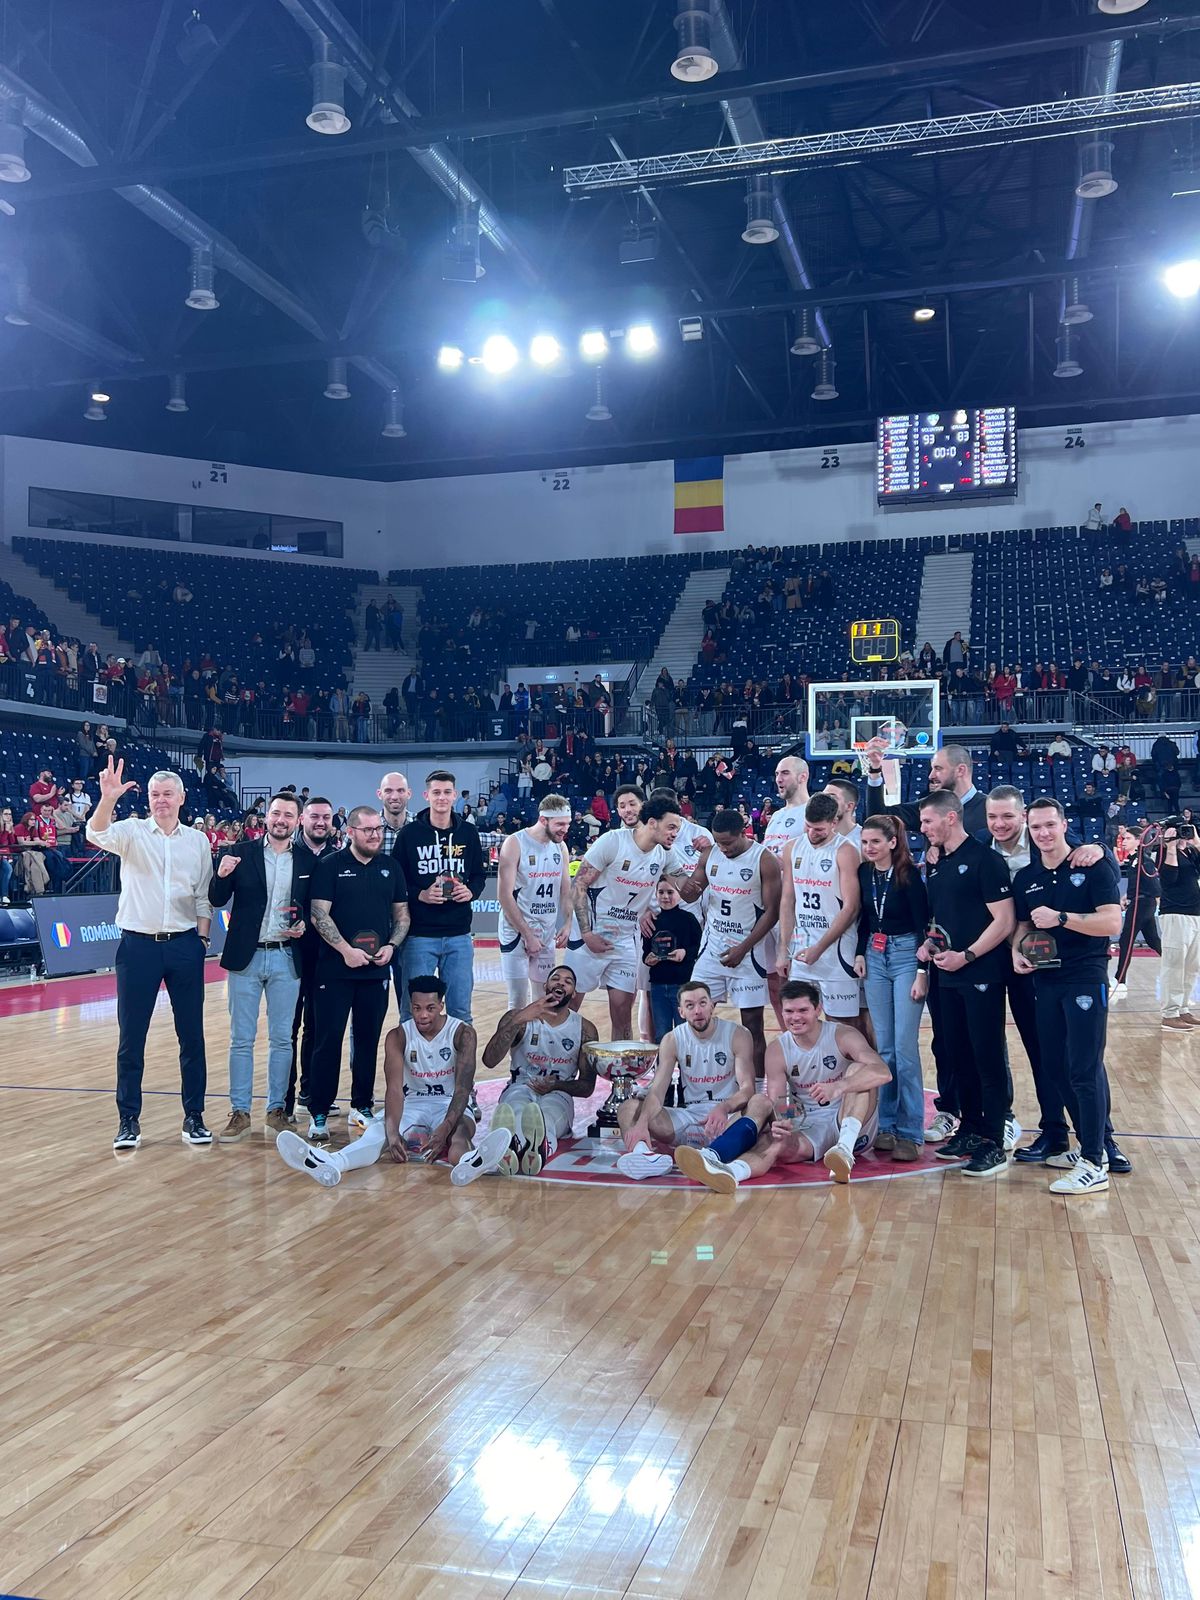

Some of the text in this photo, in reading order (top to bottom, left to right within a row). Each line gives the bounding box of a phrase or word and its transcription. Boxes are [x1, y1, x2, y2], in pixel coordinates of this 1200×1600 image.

[923, 434, 936, 445] 93
[957, 431, 970, 442] 83
[1064, 436, 1085, 448] 24
[821, 456, 840, 468] 23
[210, 470, 228, 484] 21
[553, 479, 570, 490] 22
[26, 682, 34, 698] 4
[494, 724, 502, 736] 5
[417, 844, 442, 860] WE
[418, 858, 465, 875] SOUTH
[536, 883, 554, 898] 44
[628, 892, 638, 906] 7
[802, 892, 820, 910] 33
[721, 900, 732, 916] 5
